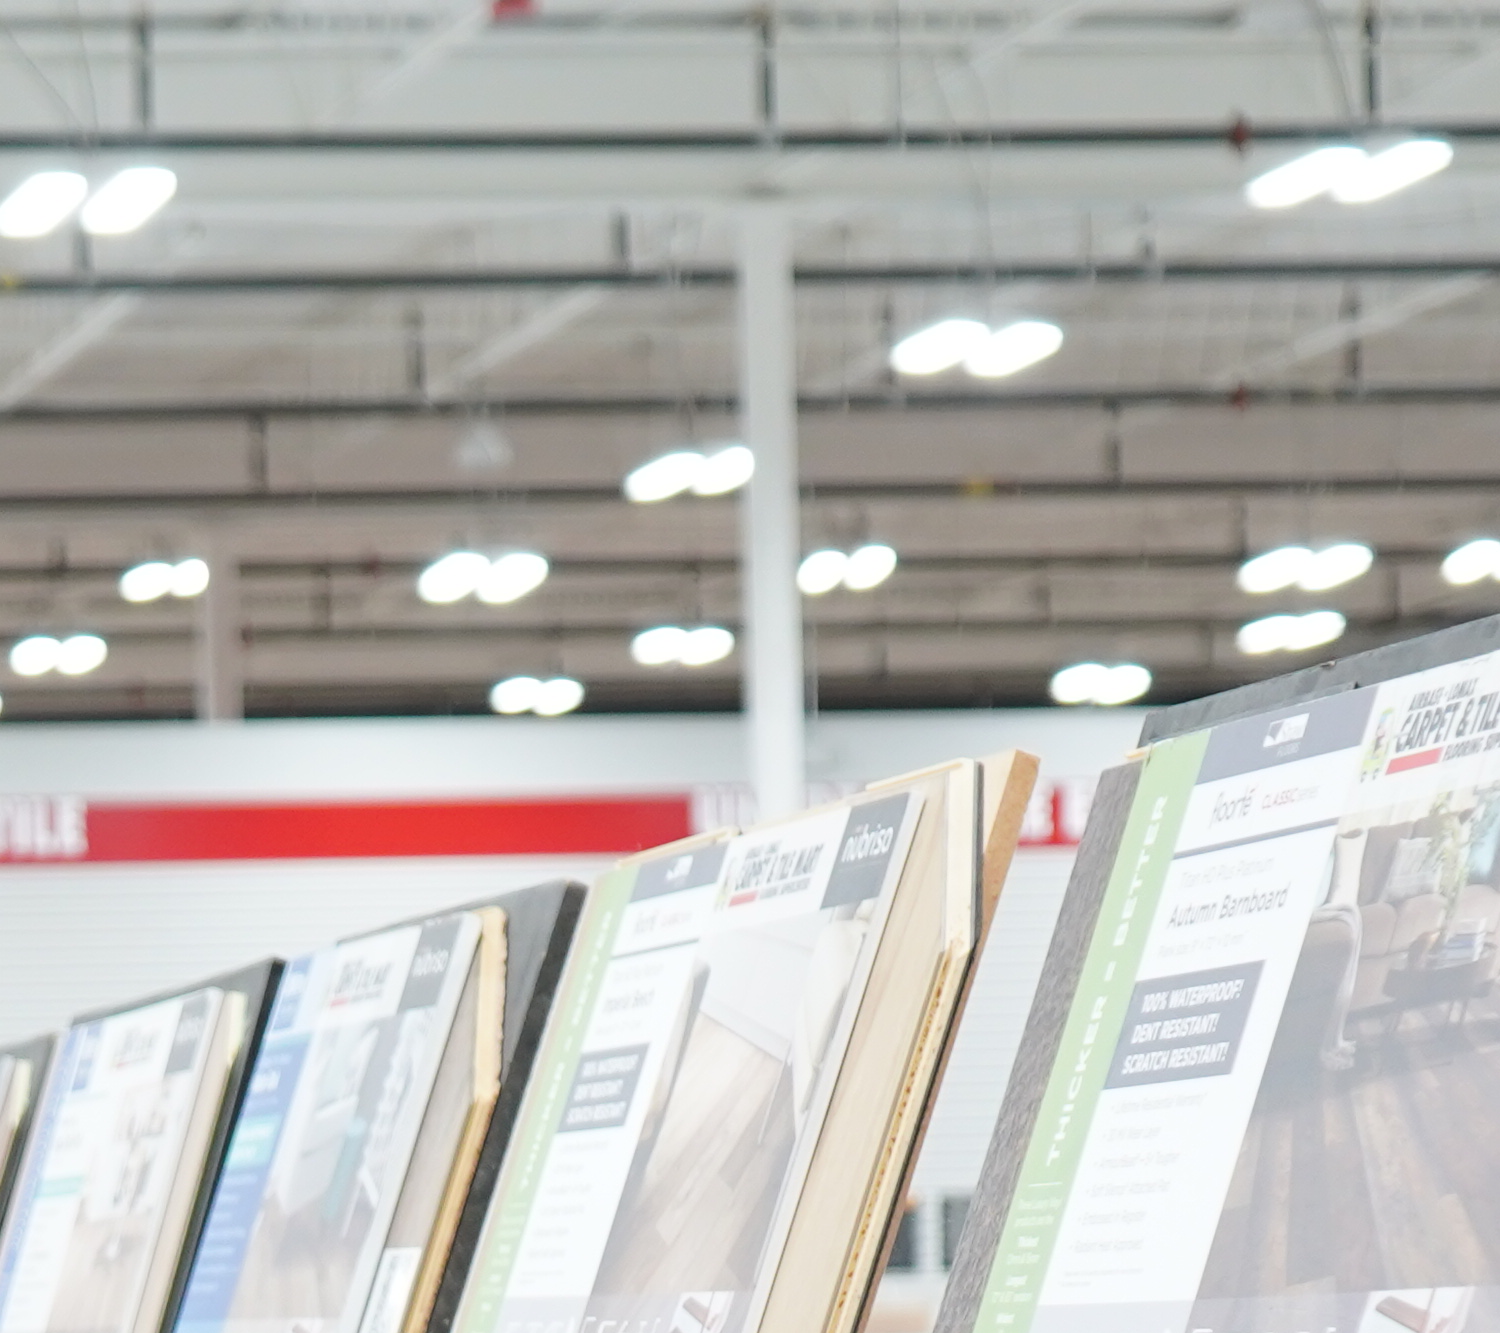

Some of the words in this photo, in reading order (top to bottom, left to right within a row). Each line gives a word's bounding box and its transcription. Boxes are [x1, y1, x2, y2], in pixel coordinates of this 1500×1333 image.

[1394, 701, 1458, 753] CARPET
[1166, 902, 1218, 930] Autumn
[1217, 880, 1290, 920] Barnboard
[1046, 995, 1108, 1168] THICKER
[1112, 795, 1169, 947] BETTER
[1140, 990, 1171, 1014] 100%
[1169, 979, 1246, 1010] WATERPROOF!
[1131, 1021, 1162, 1044] DENT
[1159, 1012, 1222, 1040] RESISTANT!
[1121, 1050, 1171, 1075] SCRATCH
[1167, 1041, 1231, 1069] RESISTANT!
